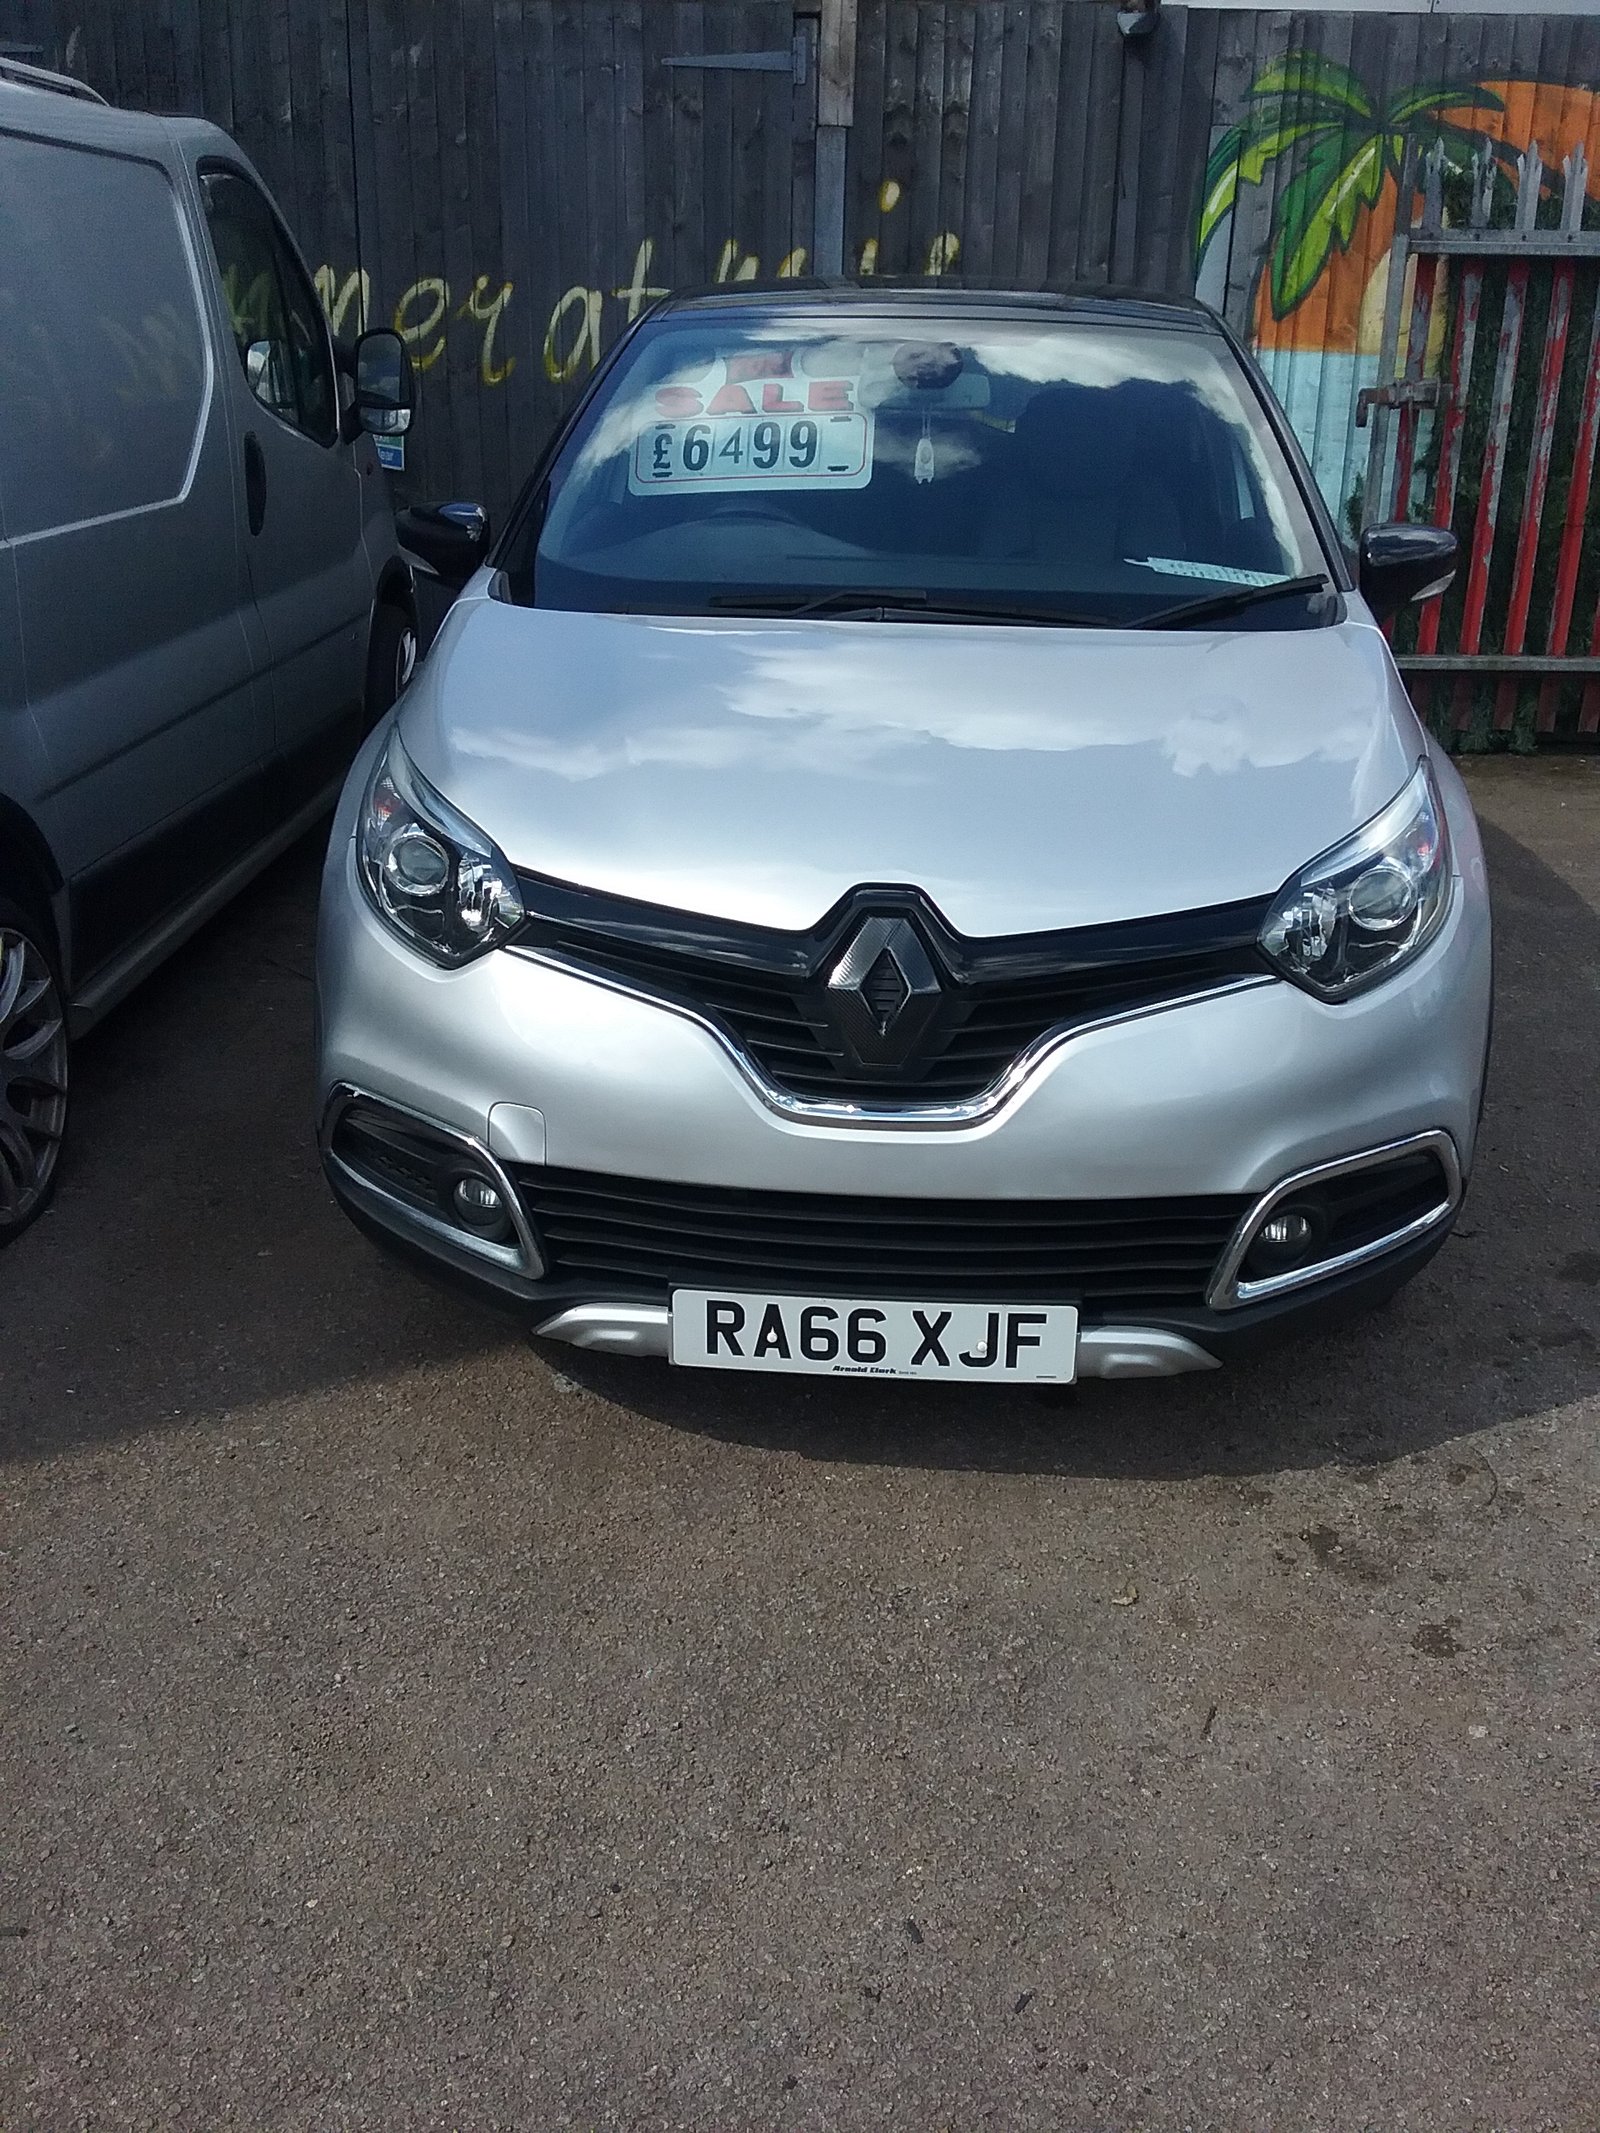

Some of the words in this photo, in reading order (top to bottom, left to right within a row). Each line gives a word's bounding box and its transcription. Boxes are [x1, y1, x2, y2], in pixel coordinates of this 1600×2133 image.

[655, 381, 854, 418] SALE
[706, 1299, 887, 1363] RA66
[911, 1310, 1047, 1369] XJF
[832, 1365, 868, 1373] Arnold
